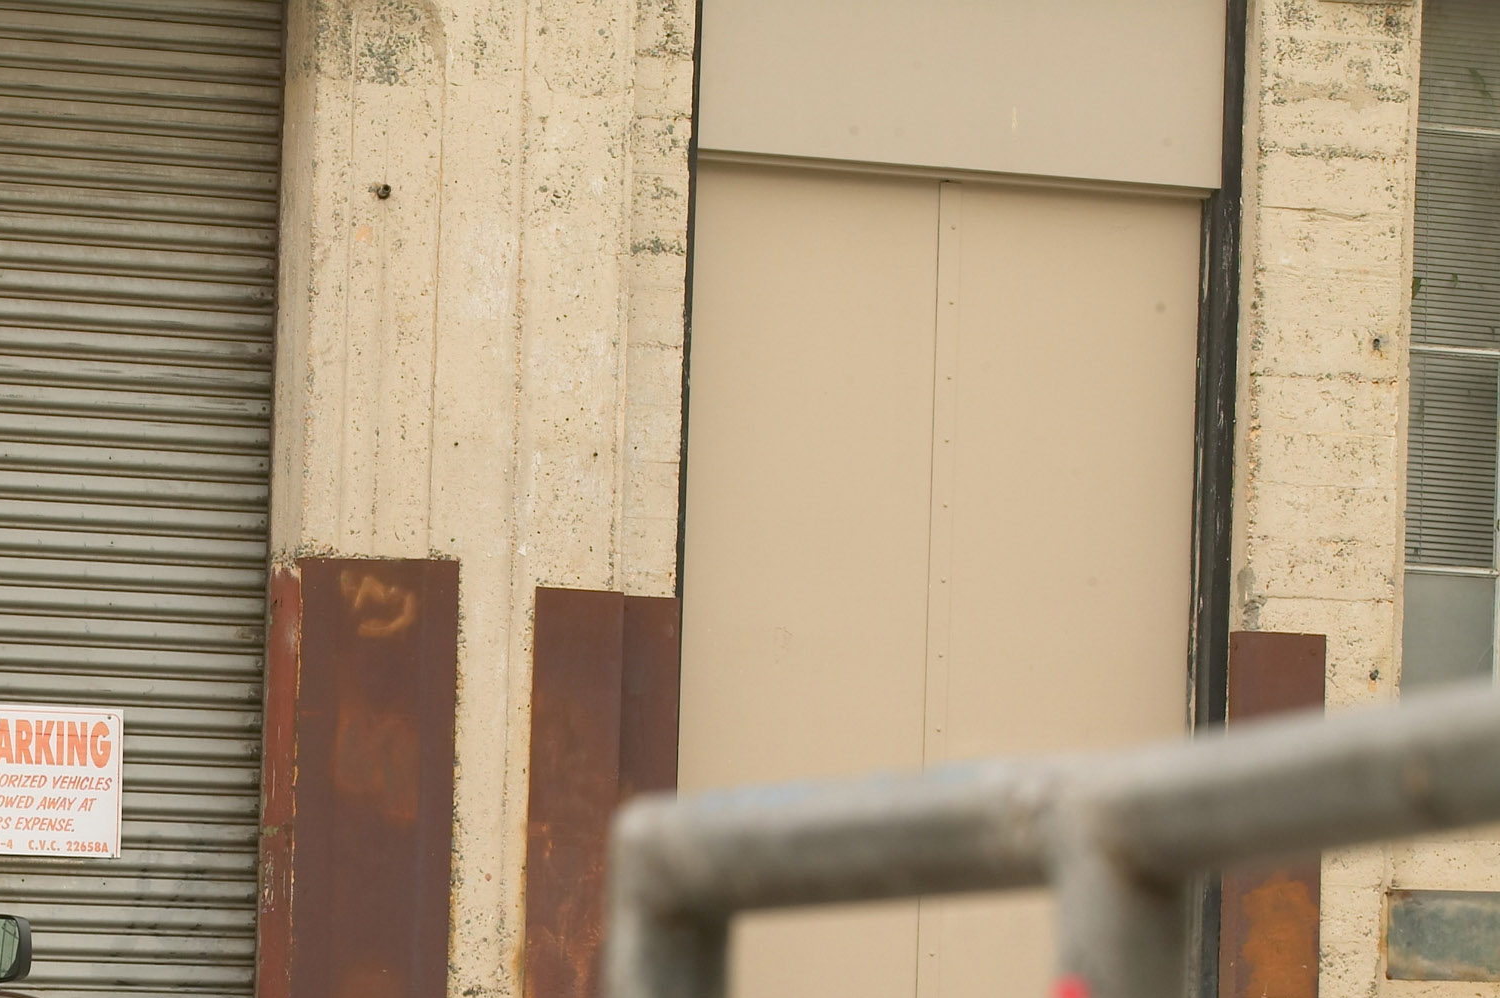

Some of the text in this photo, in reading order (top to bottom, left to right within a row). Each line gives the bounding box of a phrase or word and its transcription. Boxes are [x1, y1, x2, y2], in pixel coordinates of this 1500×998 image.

[52, 775, 112, 791] VEHICLES
[36, 796, 77, 811] AWAY
[77, 797, 97, 812] AT
[15, 817, 75, 832] EXPENSE.
[28, 840, 61, 851] C.V.C.
[66, 841, 109, 853] 22658A
